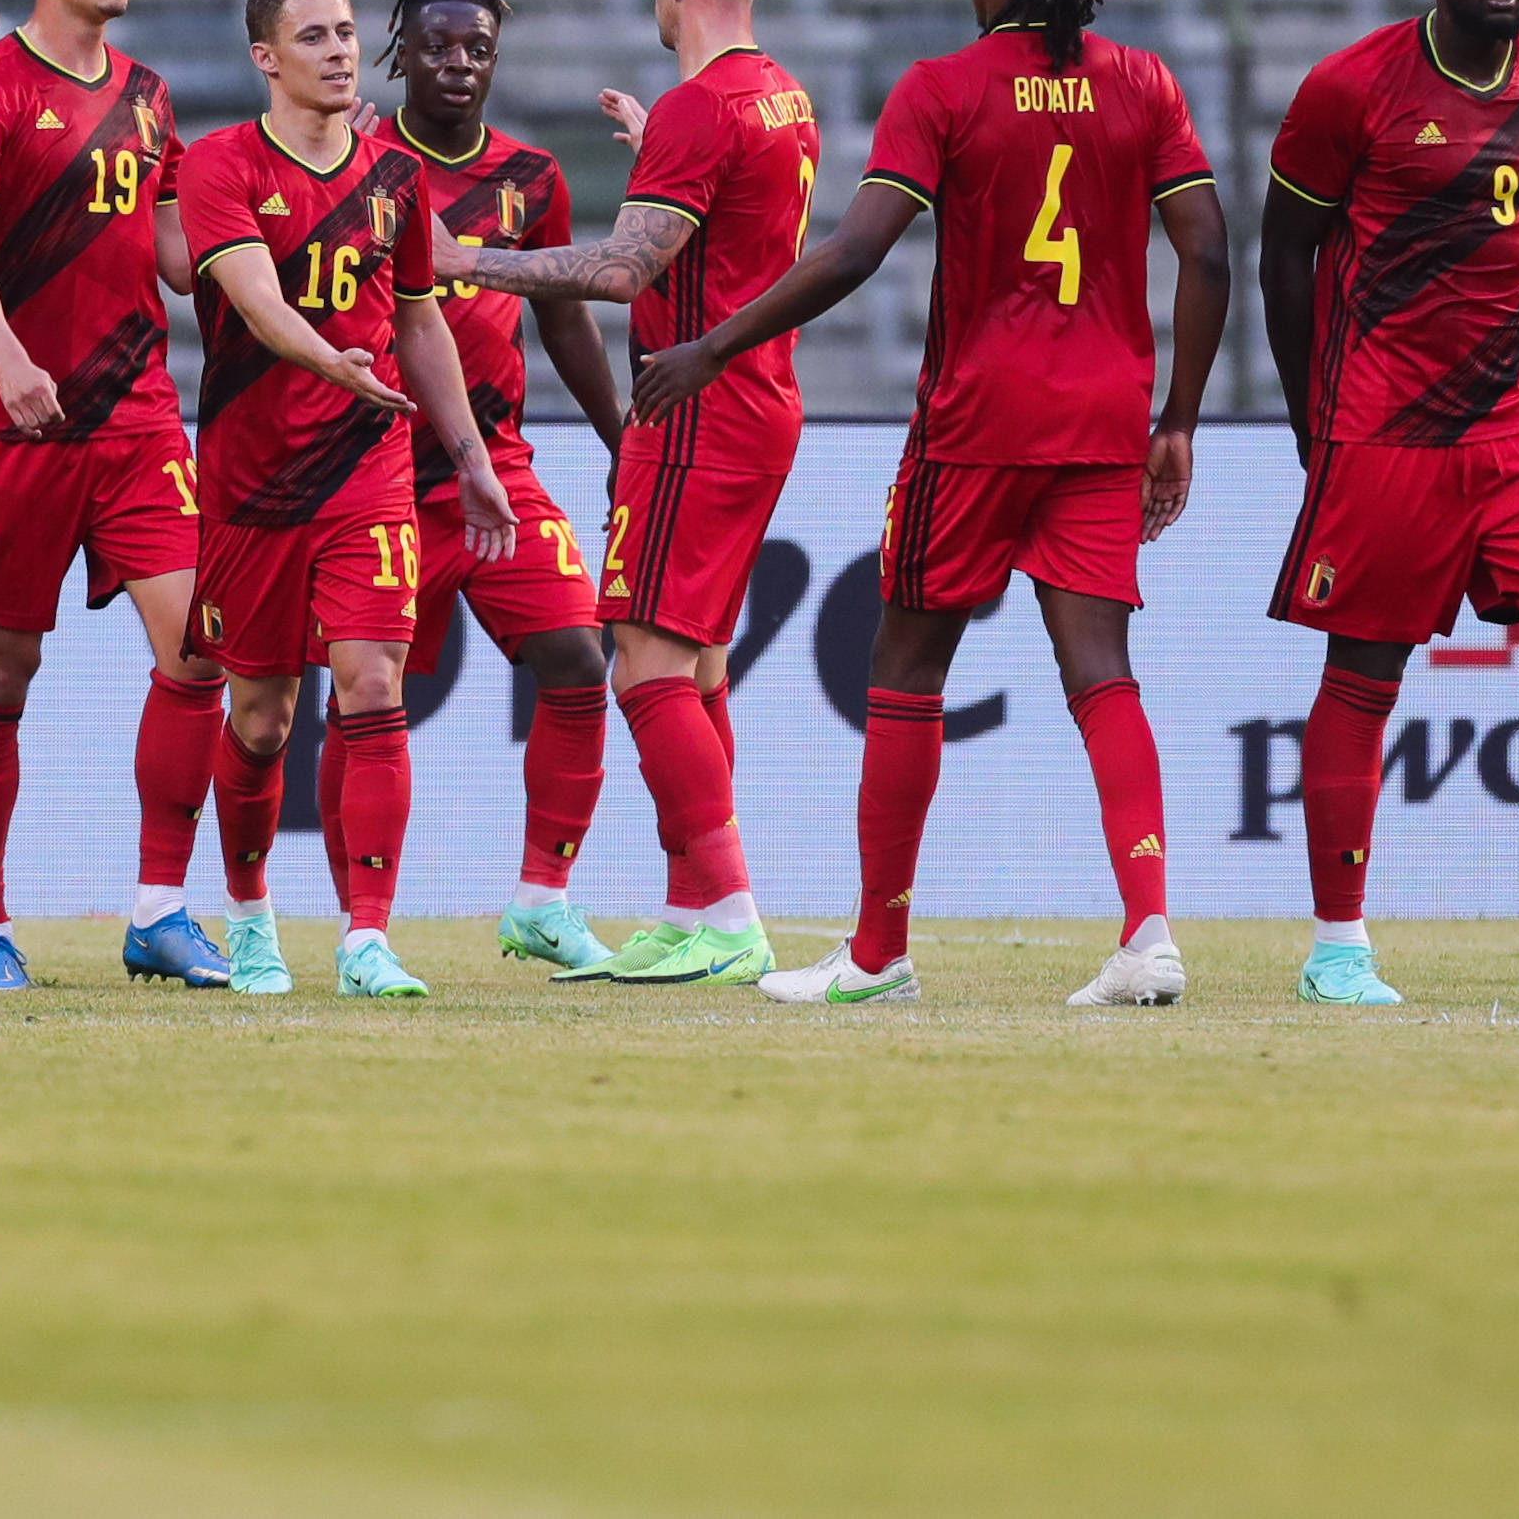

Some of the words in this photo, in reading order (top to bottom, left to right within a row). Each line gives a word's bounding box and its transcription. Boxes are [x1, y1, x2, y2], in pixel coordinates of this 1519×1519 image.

[1013, 75, 1095, 114] BOYATA
[87, 147, 139, 216] 19
[1490, 164, 1519, 227] 9
[1022, 142, 1082, 306] 4
[297, 240, 362, 312] 16
[368, 523, 419, 590] 16
[605, 504, 630, 571] 2
